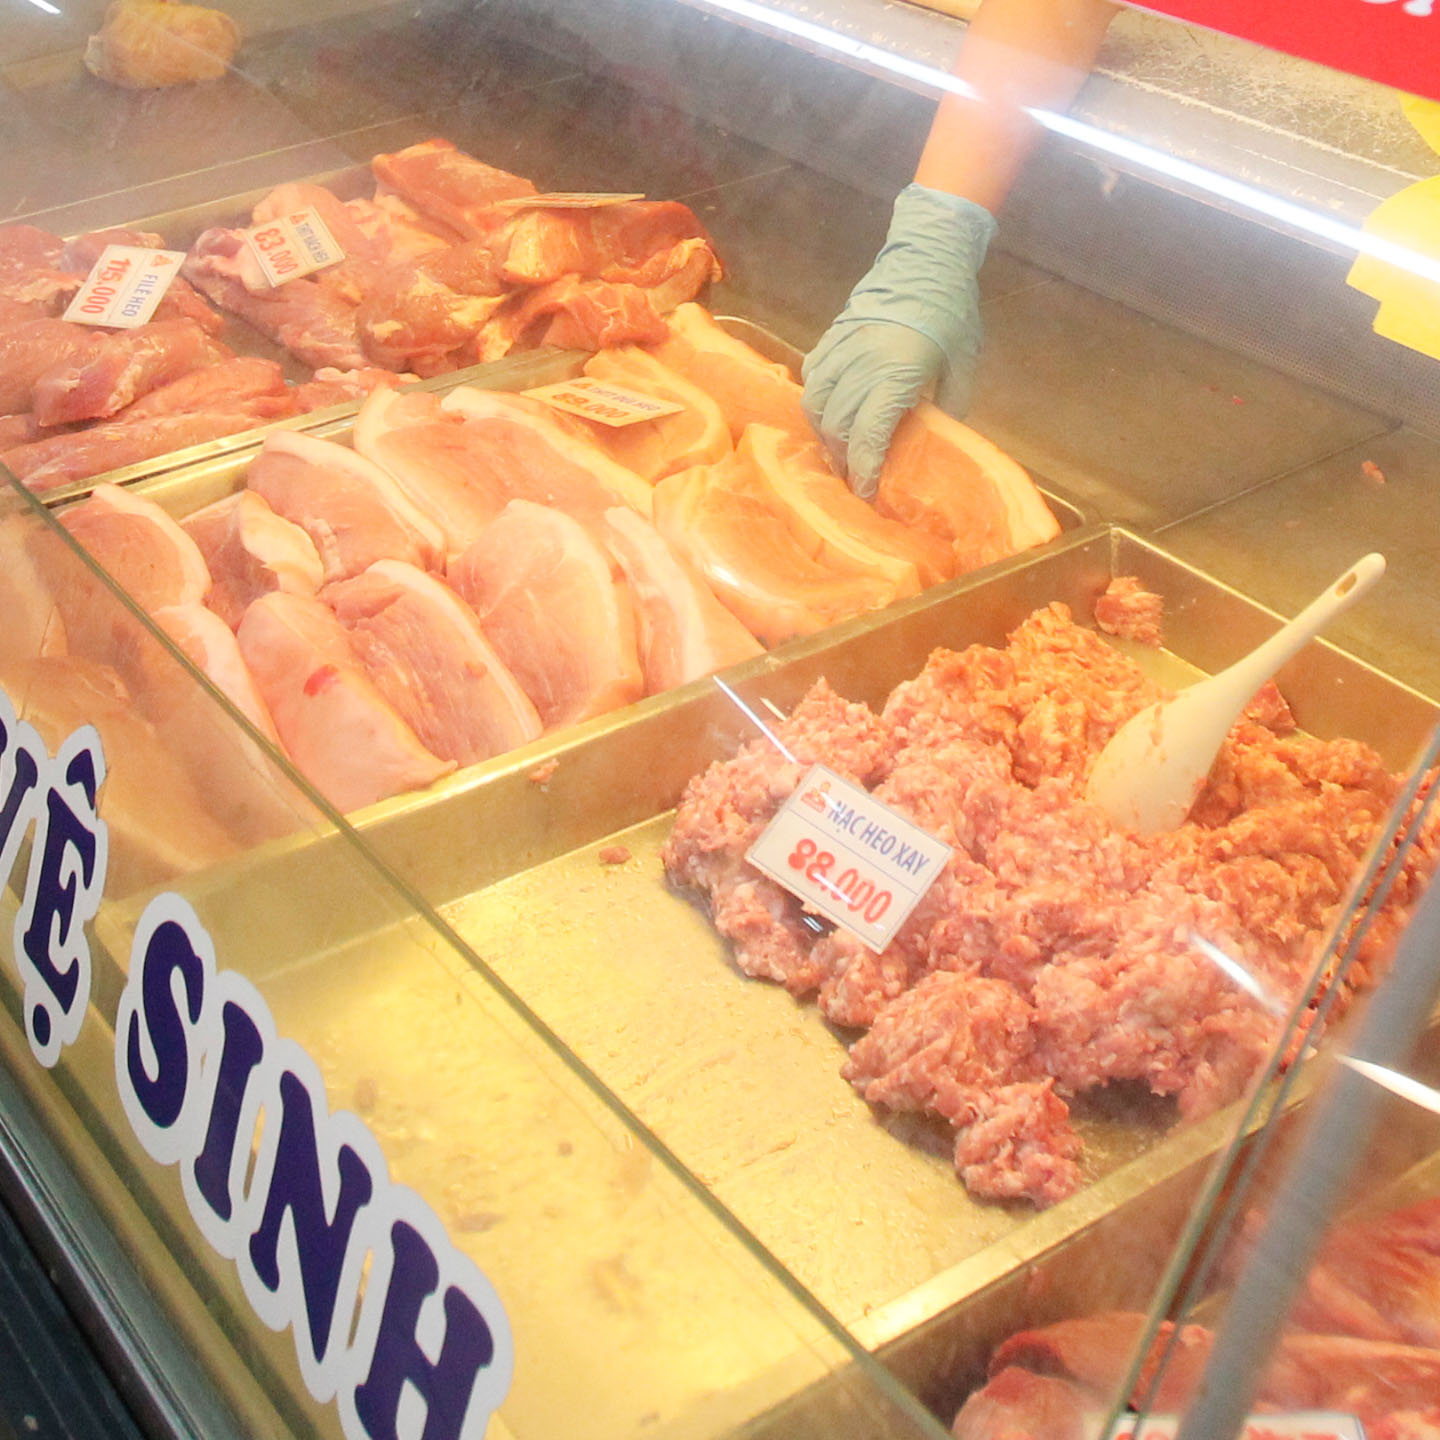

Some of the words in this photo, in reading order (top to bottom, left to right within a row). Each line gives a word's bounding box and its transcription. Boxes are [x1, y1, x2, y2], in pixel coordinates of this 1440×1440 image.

[80, 258, 131, 314] 115.000
[253, 227, 299, 275] 83.000
[827, 800, 866, 834] NẠC
[860, 822, 896, 855] HEO
[892, 842, 931, 875] XAY
[788, 838, 893, 924] 88.000
[127, 920, 495, 1440] SINH
